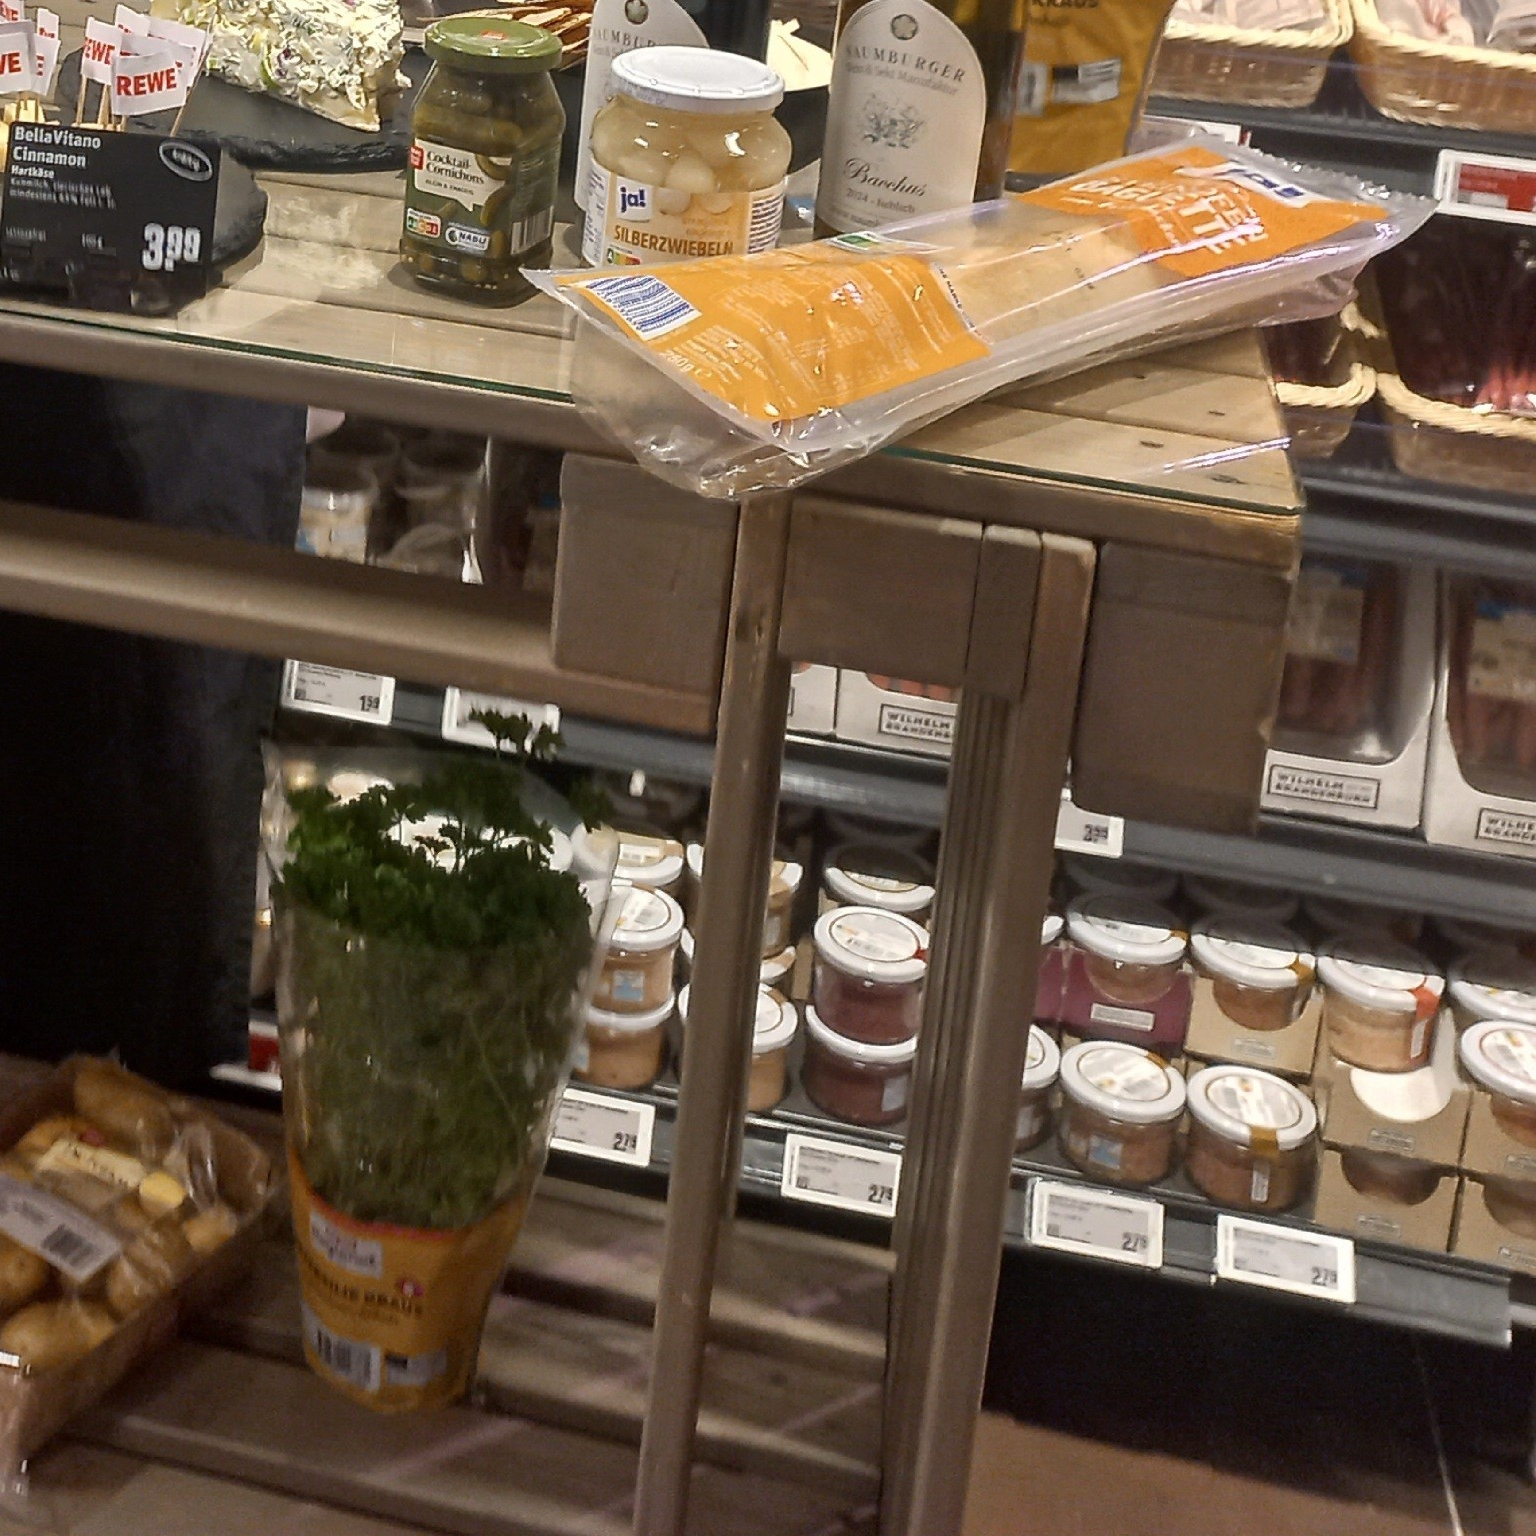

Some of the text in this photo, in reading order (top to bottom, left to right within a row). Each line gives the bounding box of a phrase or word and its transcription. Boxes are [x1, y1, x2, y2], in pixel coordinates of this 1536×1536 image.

[116, 64, 178, 97] REWE
[14, 126, 102, 150] BellaVitano
[12, 146, 87, 169] Cinnamon
[11, 165, 55, 179] Hartkäse
[426, 161, 485, 185] Cornichons
[844, 157, 928, 197] Bacchus
[620, 186, 647, 213] ja!
[458, 232, 487, 244] NABU
[613, 225, 734, 256] SILBERZWIEBELN
[887, 711, 951, 729] WILHELM
